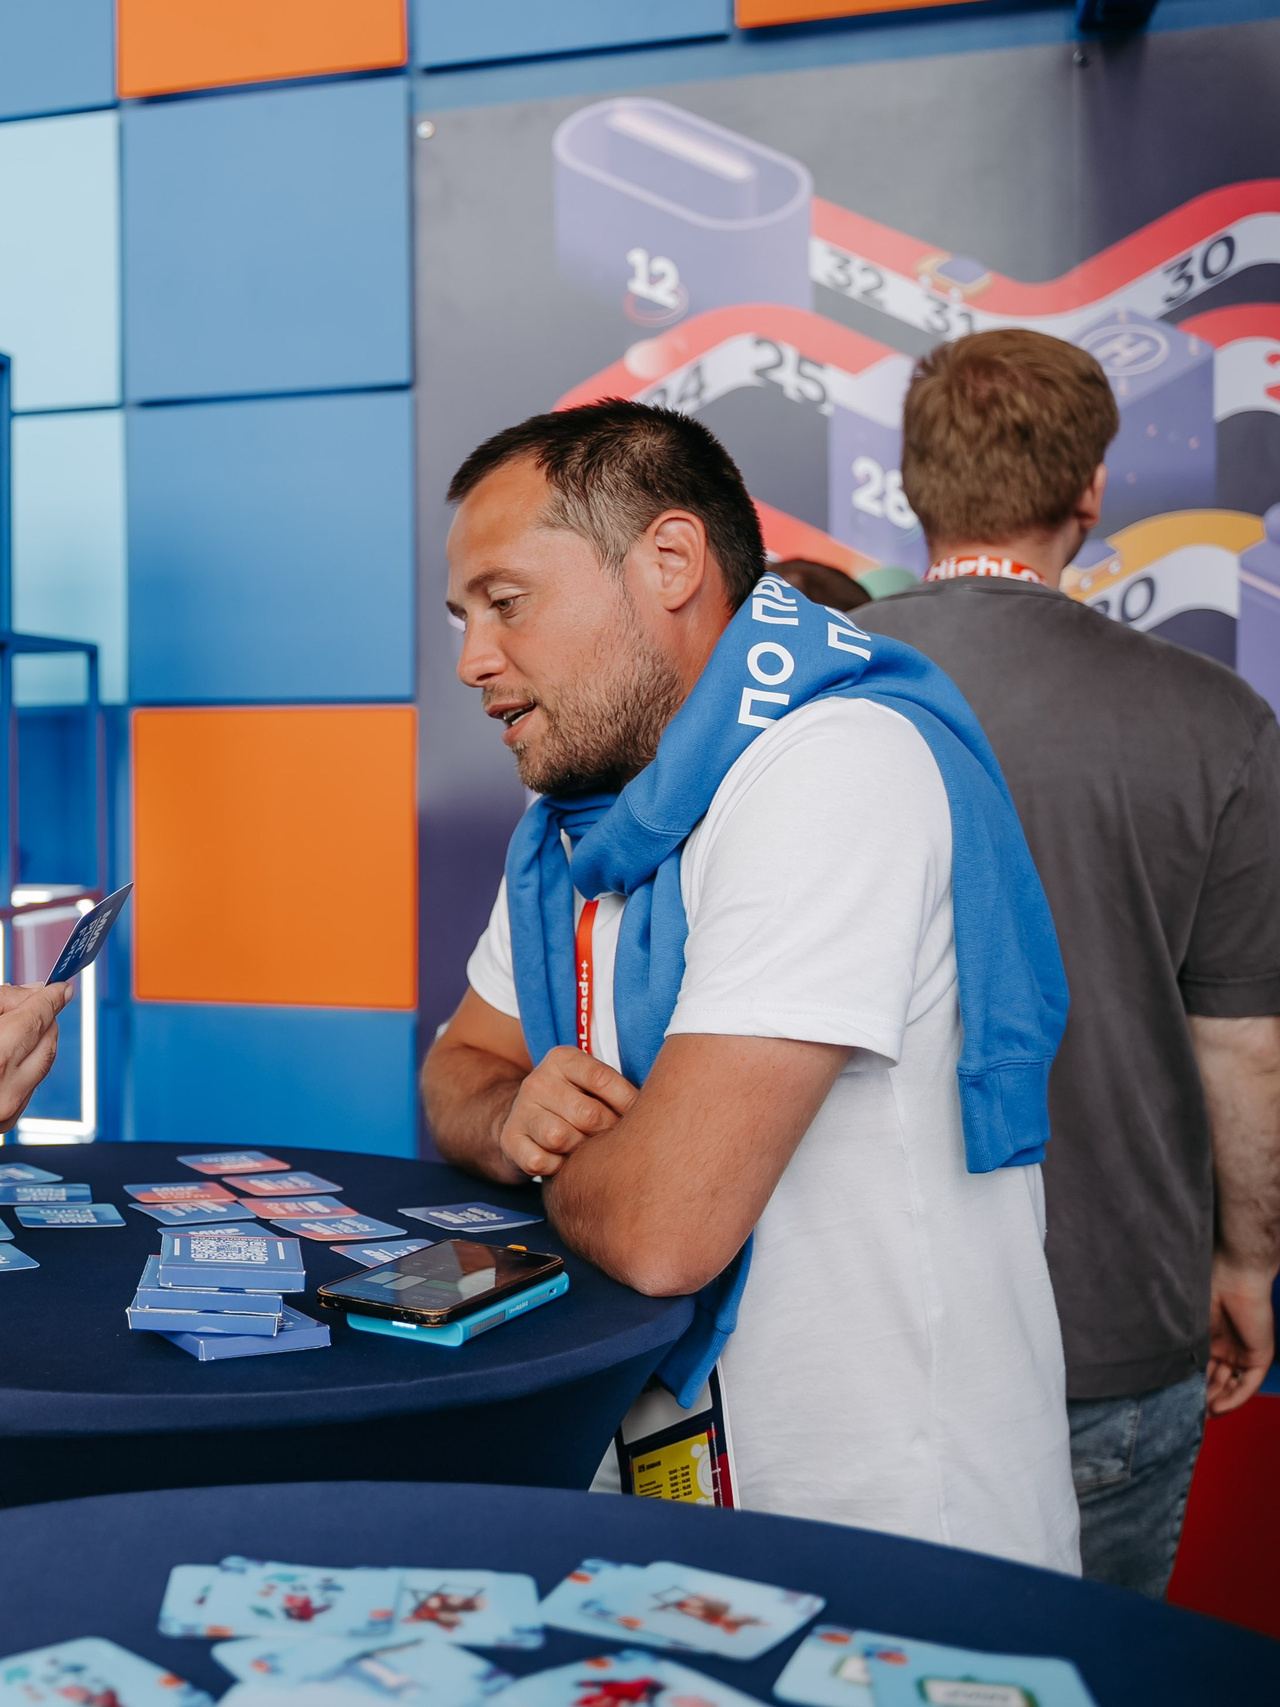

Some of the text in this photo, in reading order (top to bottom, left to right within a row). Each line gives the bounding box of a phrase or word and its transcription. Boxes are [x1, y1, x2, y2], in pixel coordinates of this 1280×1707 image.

[627, 247, 680, 309] 12
[824, 246, 884, 298] 32
[1162, 234, 1236, 306] 30
[754, 337, 828, 404] 25
[924, 555, 1044, 584] HighLo
[737, 641, 795, 729] ПО
[58, 925, 88, 974] Form
[86, 908, 113, 953] МИР
